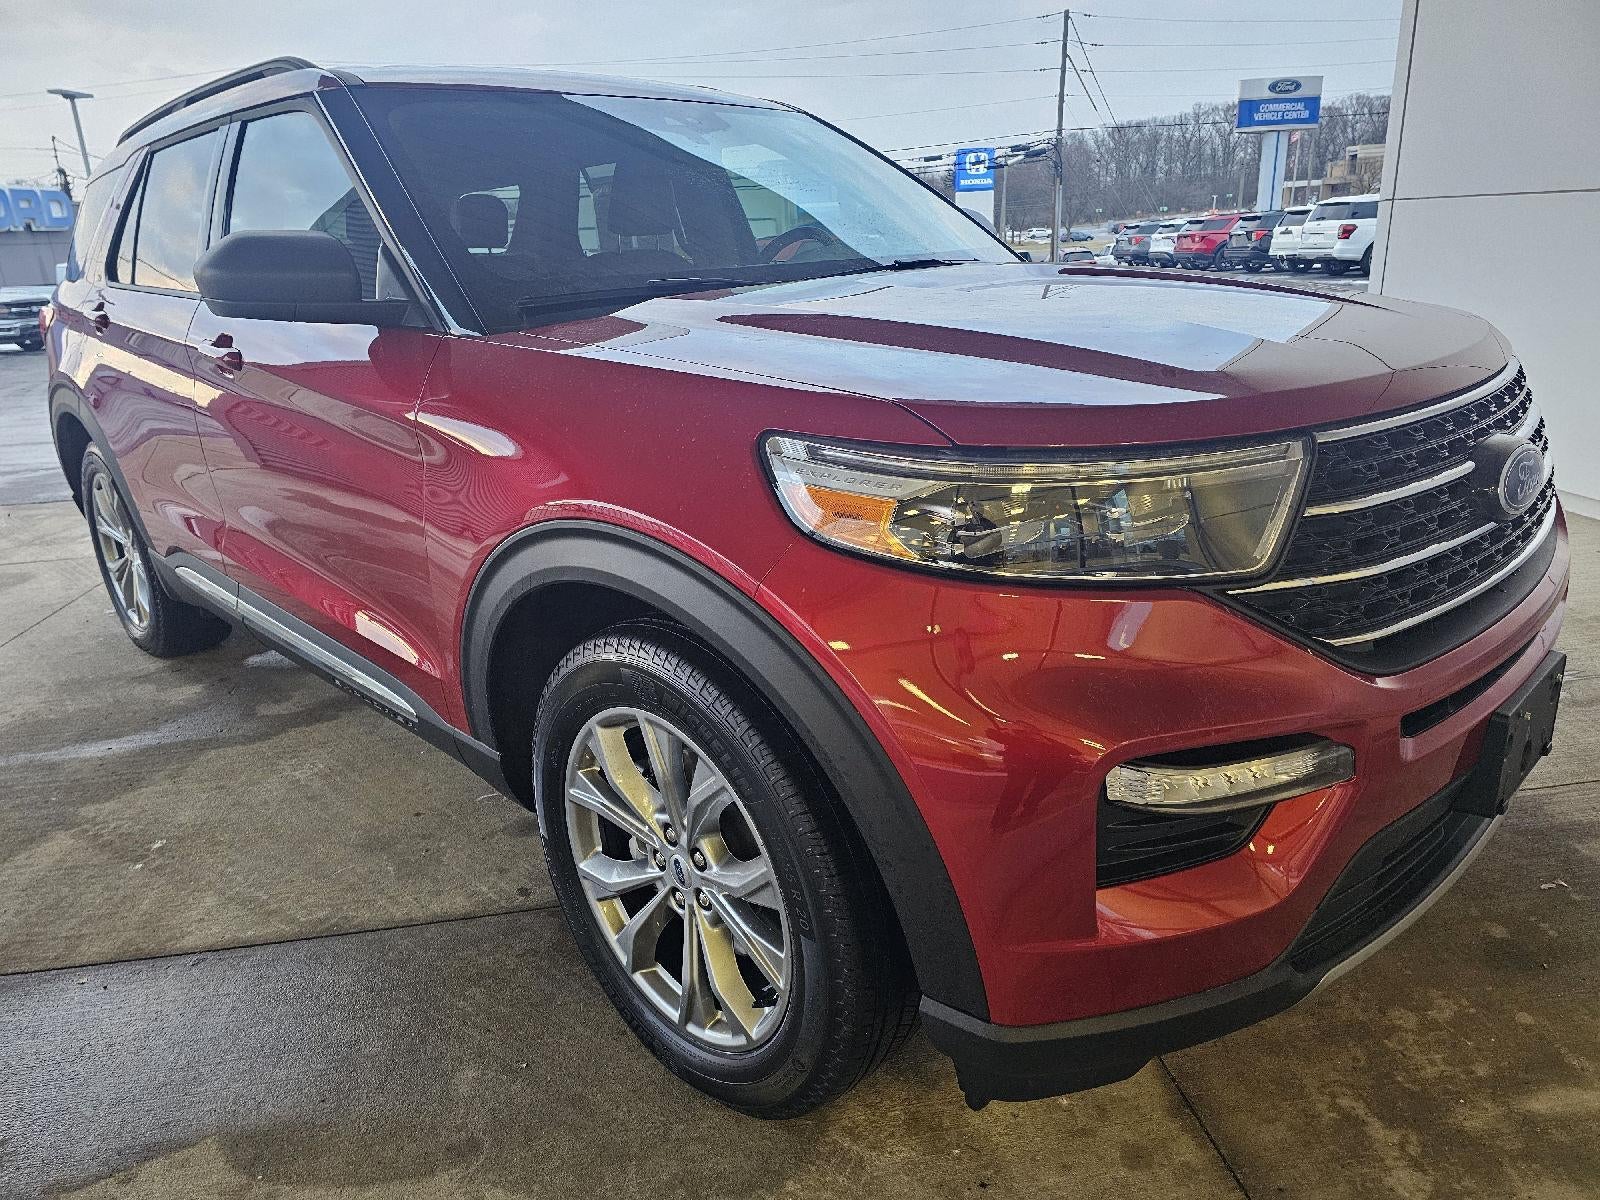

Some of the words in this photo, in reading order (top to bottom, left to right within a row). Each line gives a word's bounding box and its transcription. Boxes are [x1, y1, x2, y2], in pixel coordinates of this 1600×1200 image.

[1276, 81, 1297, 91] Ford
[1260, 102, 1305, 113] COMMERCIAL
[1253, 111, 1283, 121] VEHICLE
[1284, 110, 1310, 119] CENTER
[795, 468, 903, 491] EXPLORER
[1517, 457, 1541, 501] Ford
